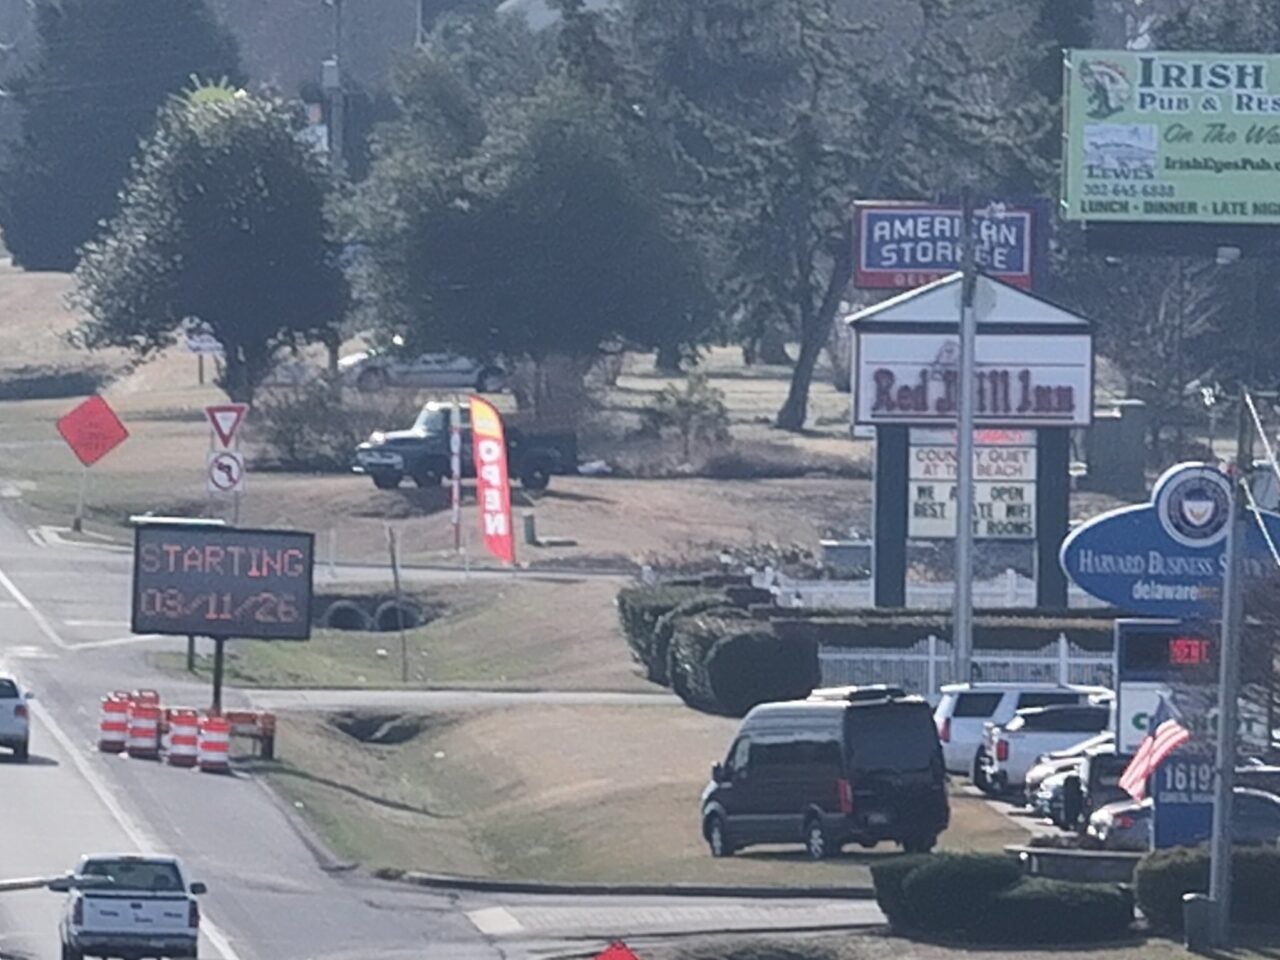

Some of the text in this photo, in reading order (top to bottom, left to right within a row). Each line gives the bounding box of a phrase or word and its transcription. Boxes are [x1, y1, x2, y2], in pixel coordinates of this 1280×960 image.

[1139, 57, 1264, 89] IRISH
[1139, 93, 1190, 111] PUB
[1202, 97, 1219, 112] &
[1163, 123, 1194, 144] On
[1203, 123, 1237, 144] The
[1086, 165, 1155, 181] LEWES
[1081, 201, 1130, 214] LUNCH
[1143, 201, 1198, 214] DINNER
[1212, 202, 1249, 215] LATE
[871, 368, 928, 413] Red
[1017, 368, 1075, 414] Inn
[988, 449, 1030, 463] QUIET
[477, 438, 508, 536] OPEN
[990, 486, 1024, 501] OPEN
[914, 501, 946, 518] BEST
[986, 520, 1033, 535] ROOMS
[140, 543, 304, 577] STARTING
[1079, 549, 1145, 574] HARVARD
[1148, 550, 1214, 576] BUSINESS
[139, 588, 299, 624] 03/11/26
